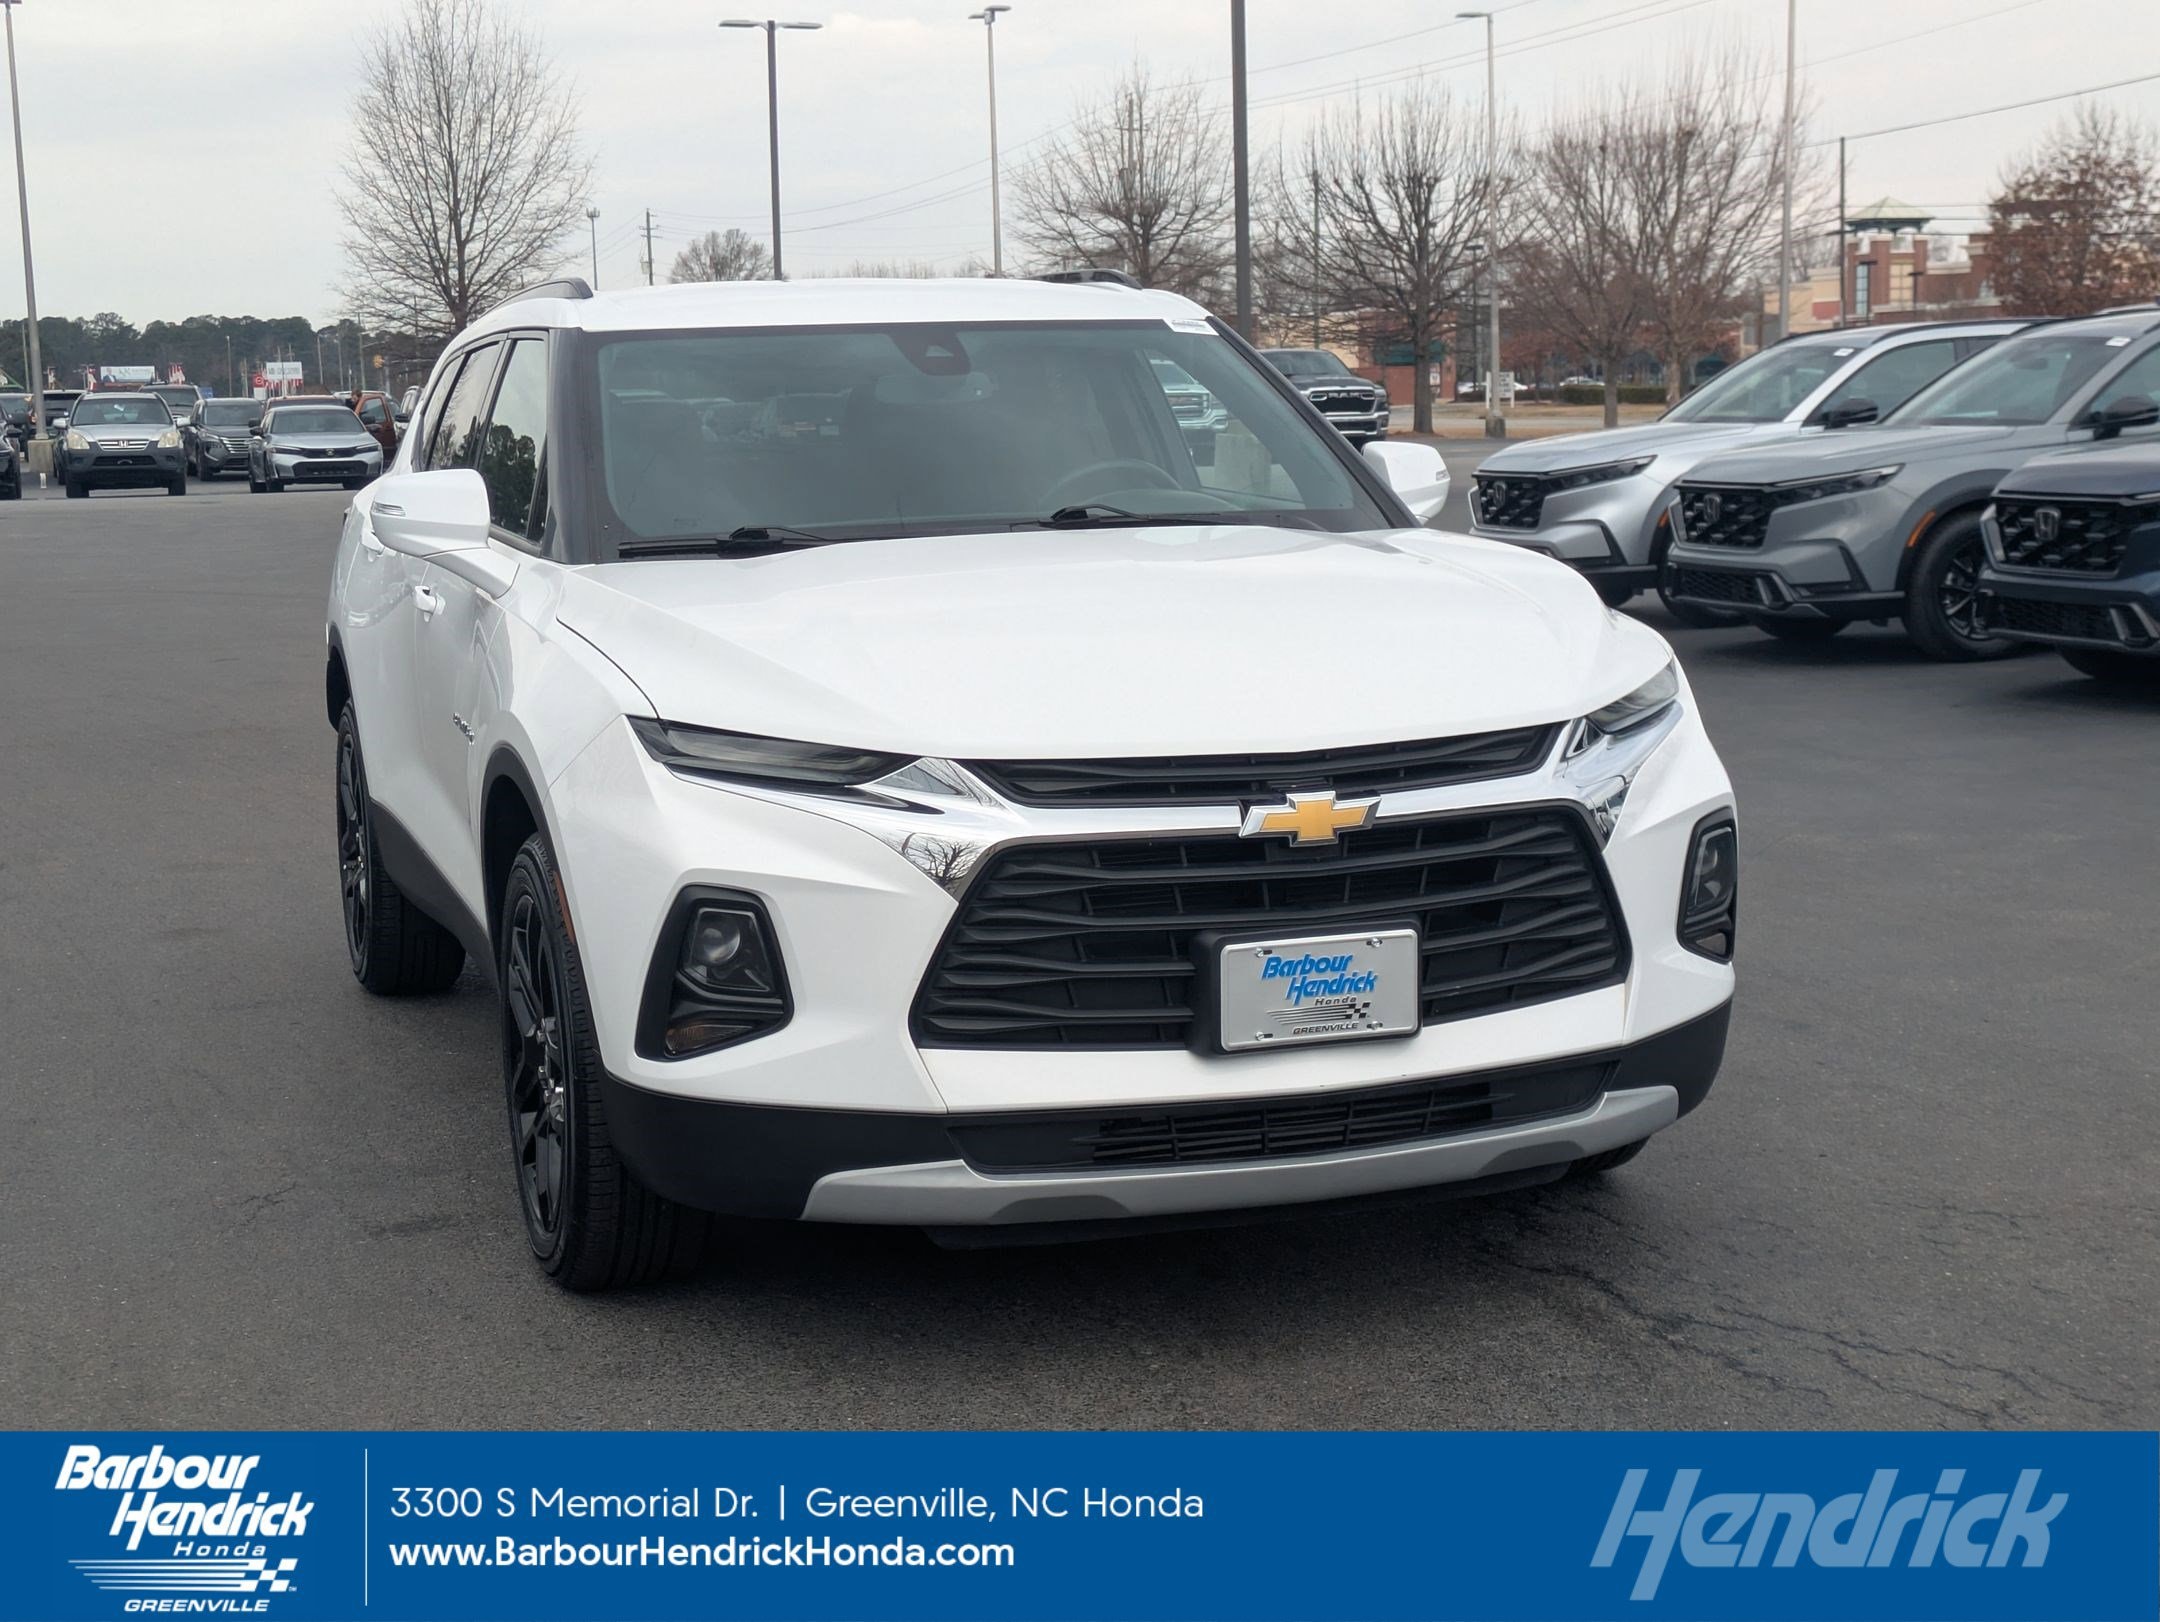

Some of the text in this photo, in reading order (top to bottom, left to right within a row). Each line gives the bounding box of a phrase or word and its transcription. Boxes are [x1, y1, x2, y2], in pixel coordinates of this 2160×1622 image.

[1262, 954, 1353, 980] Barbour
[1285, 970, 1378, 1006] Hendrick
[1315, 995, 1357, 1006] Honda
[1293, 1022, 1359, 1035] GREENVILLE
